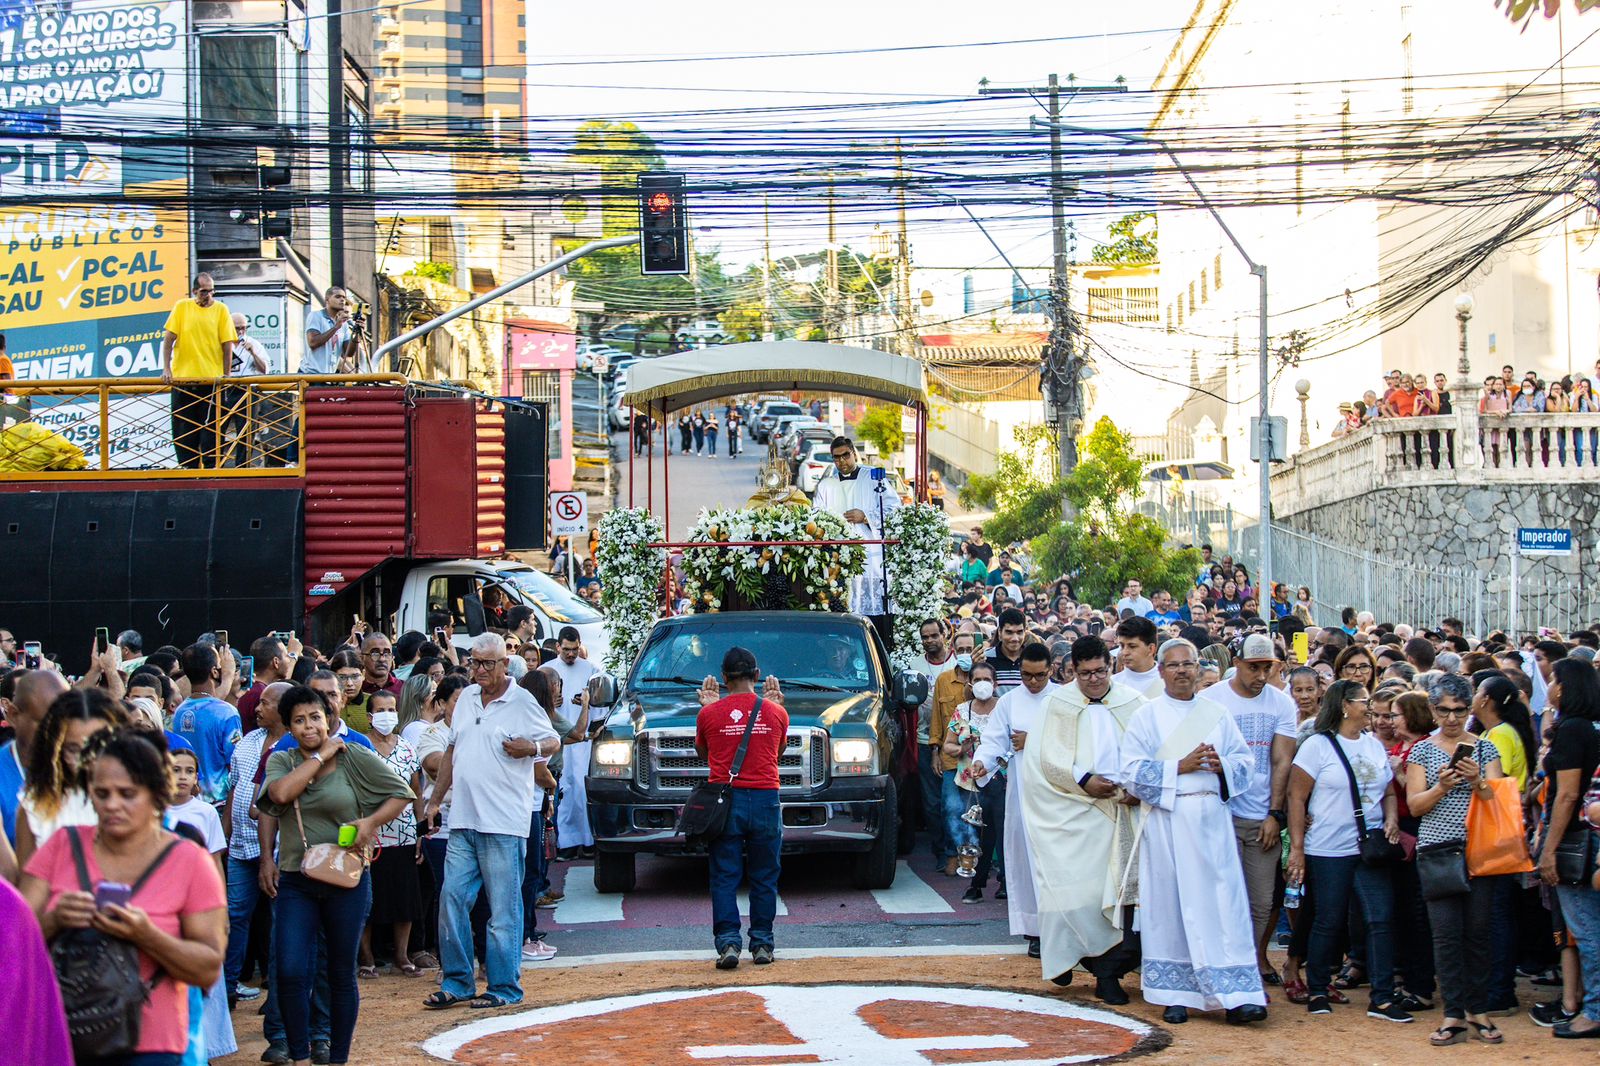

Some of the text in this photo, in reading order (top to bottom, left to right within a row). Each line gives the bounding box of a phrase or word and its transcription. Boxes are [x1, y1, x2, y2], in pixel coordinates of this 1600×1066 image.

[22, 15, 37, 40] É
[41, 18, 58, 37] O
[60, 12, 109, 35] ANO
[112, 8, 157, 33] DOS
[24, 25, 173, 60] CONCURSOS
[18, 63, 52, 80] SER
[56, 61, 69, 77] O
[72, 57, 113, 75] ANO
[115, 53, 141, 70] DA
[0, 70, 162, 108] APROVAÇÃO!
[8, 225, 164, 255] PÚBLICOS
[82, 250, 163, 281] PC-AL
[79, 279, 164, 309] SEDUC
[11, 343, 87, 361] PREPARATÓRIO
[13, 352, 95, 381] ENEM
[105, 341, 165, 377] OA
[32, 412, 83, 426] OFICIAL
[113, 424, 156, 437] PRADO
[556, 525, 576, 533] INÍCIO
[1521, 530, 1567, 544] Imperador
